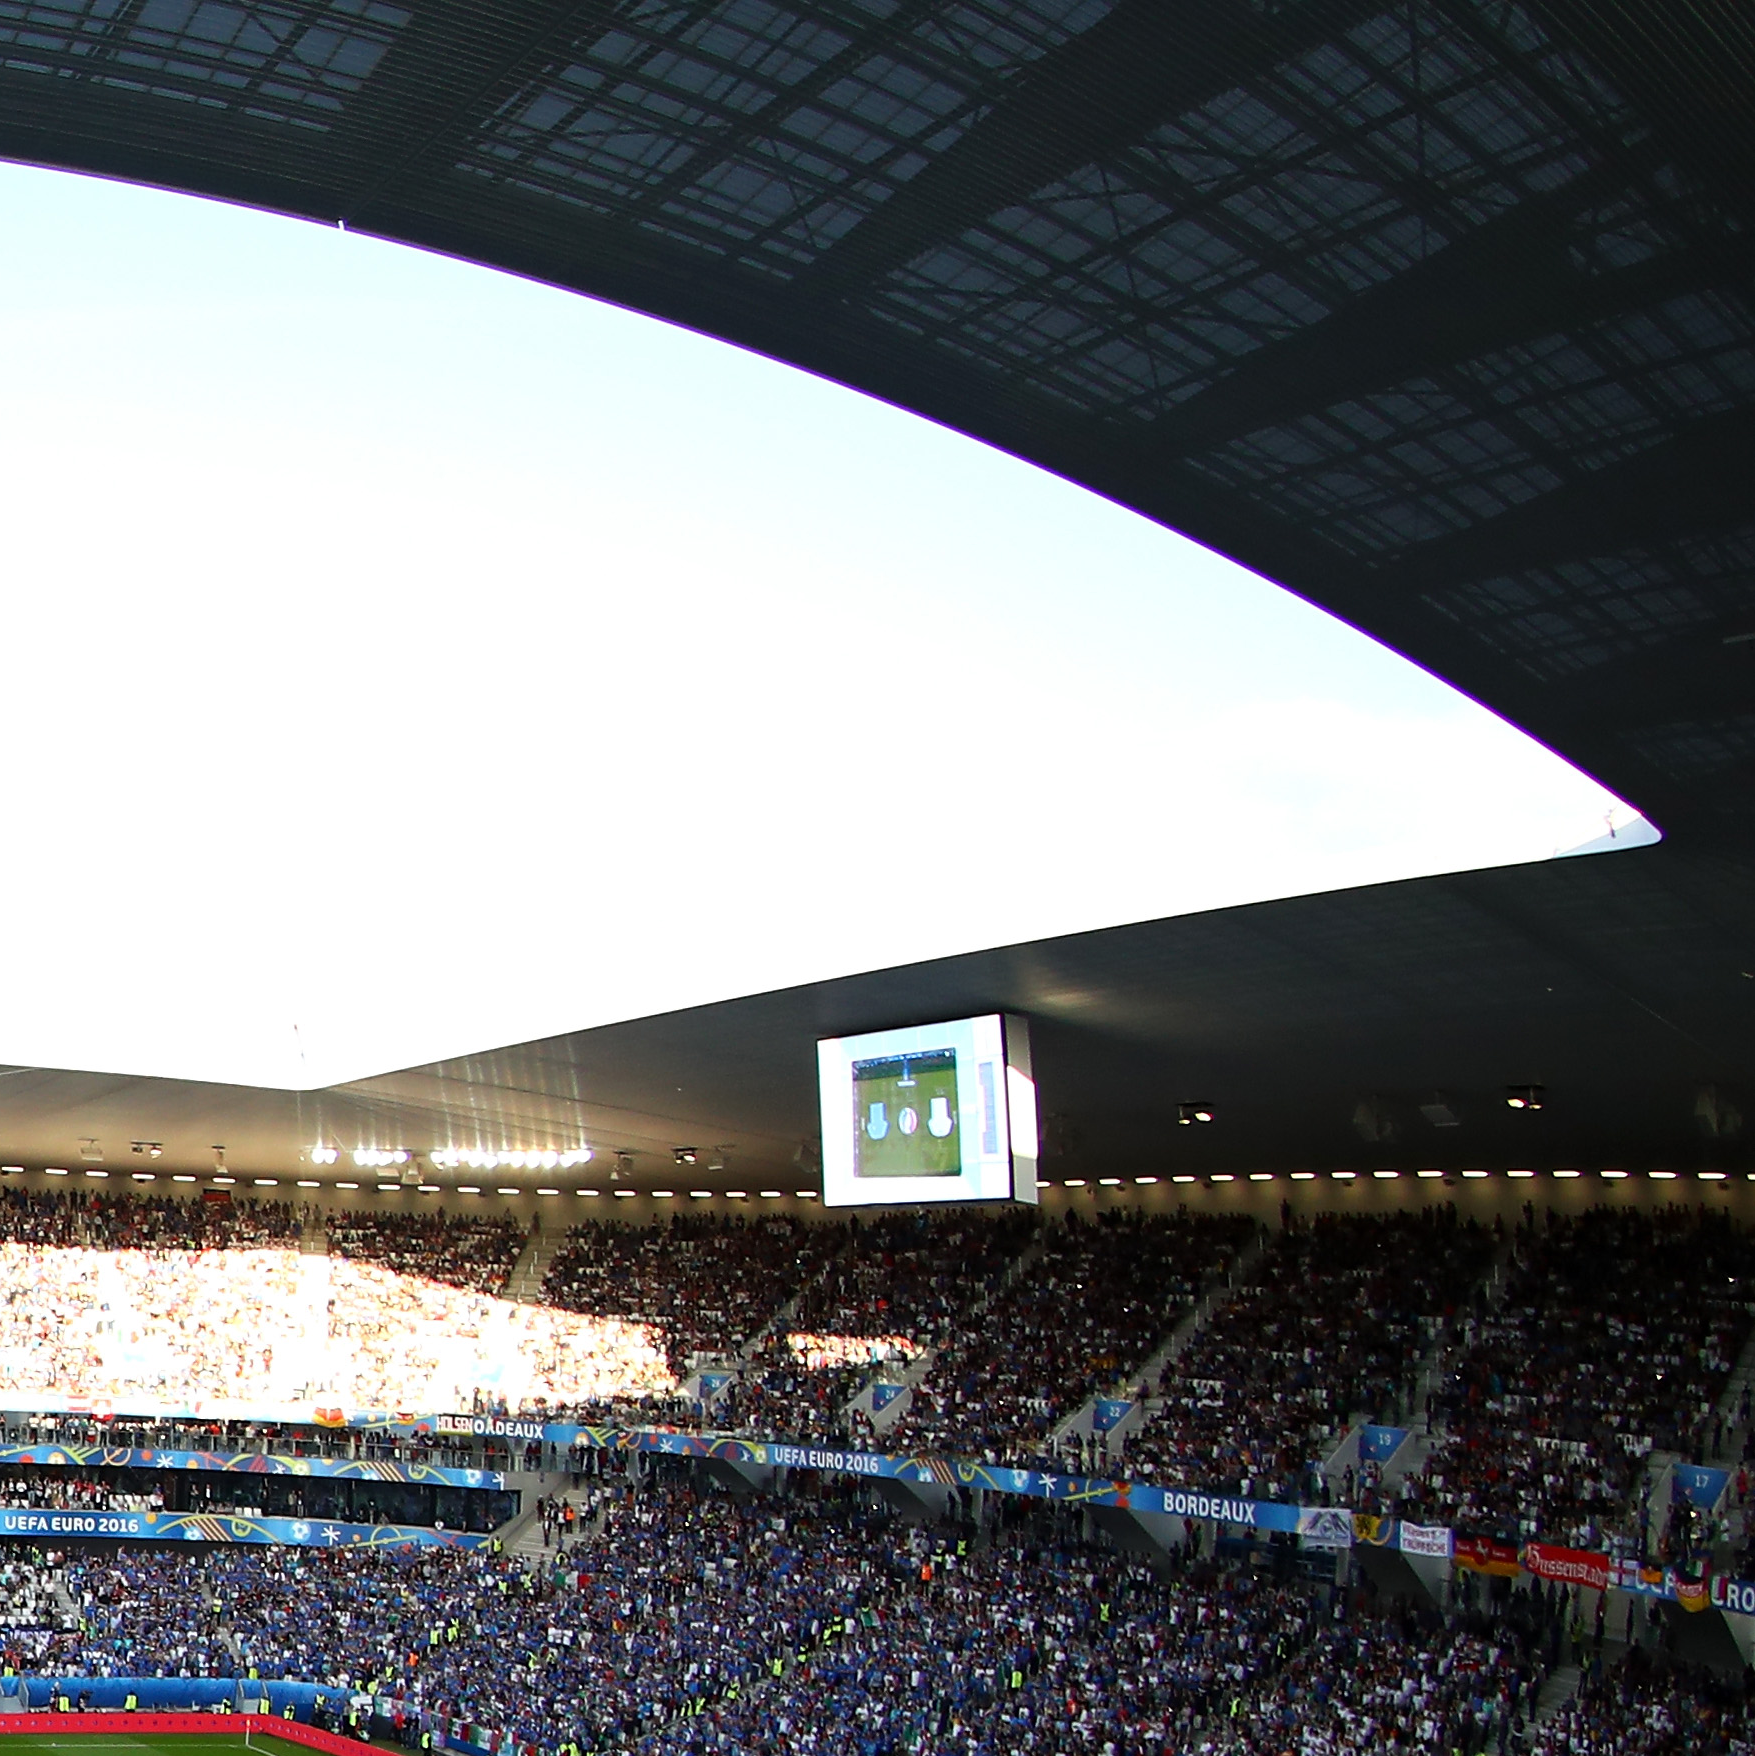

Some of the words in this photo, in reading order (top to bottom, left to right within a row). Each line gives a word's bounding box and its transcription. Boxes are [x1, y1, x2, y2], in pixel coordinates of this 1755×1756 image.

[774, 1446, 808, 1466] UEFA
[809, 1450, 844, 1470] EURO
[845, 1453, 879, 1474] 2016
[1162, 1492, 1256, 1525] BORDEAUX
[4, 1515, 49, 1532] UEFA
[51, 1516, 96, 1533] EURO
[97, 1516, 139, 1534] 2016
